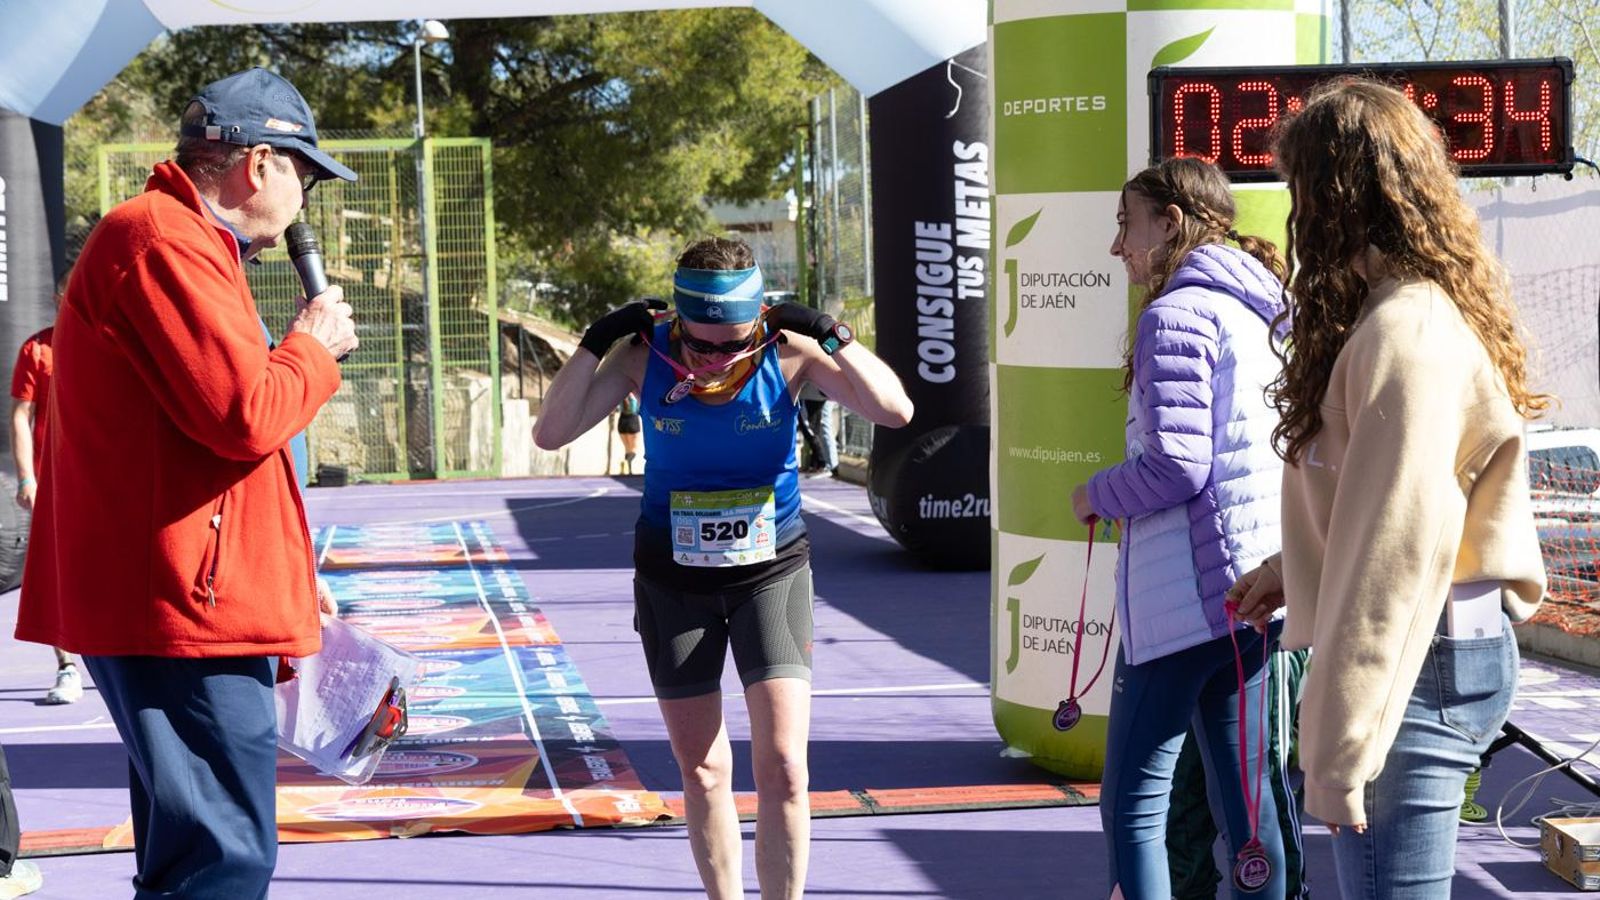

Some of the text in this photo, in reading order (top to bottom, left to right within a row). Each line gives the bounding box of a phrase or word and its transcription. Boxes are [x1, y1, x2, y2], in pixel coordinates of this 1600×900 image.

[1003, 95, 1106, 116] DEPORTES
[952, 139, 991, 300] TUS METAS
[1021, 269, 1111, 288] DIPUTACIÓN
[914, 220, 957, 384] CONSIGUE
[1021, 291, 1075, 309] DE JAÉN
[1008, 446, 1102, 464] www.dipujaen.es
[918, 493, 991, 519] time2ru
[700, 519, 749, 542] 520
[1023, 613, 1112, 637] DIPUTACIÓN
[1023, 635, 1077, 655] DE JAÉN
